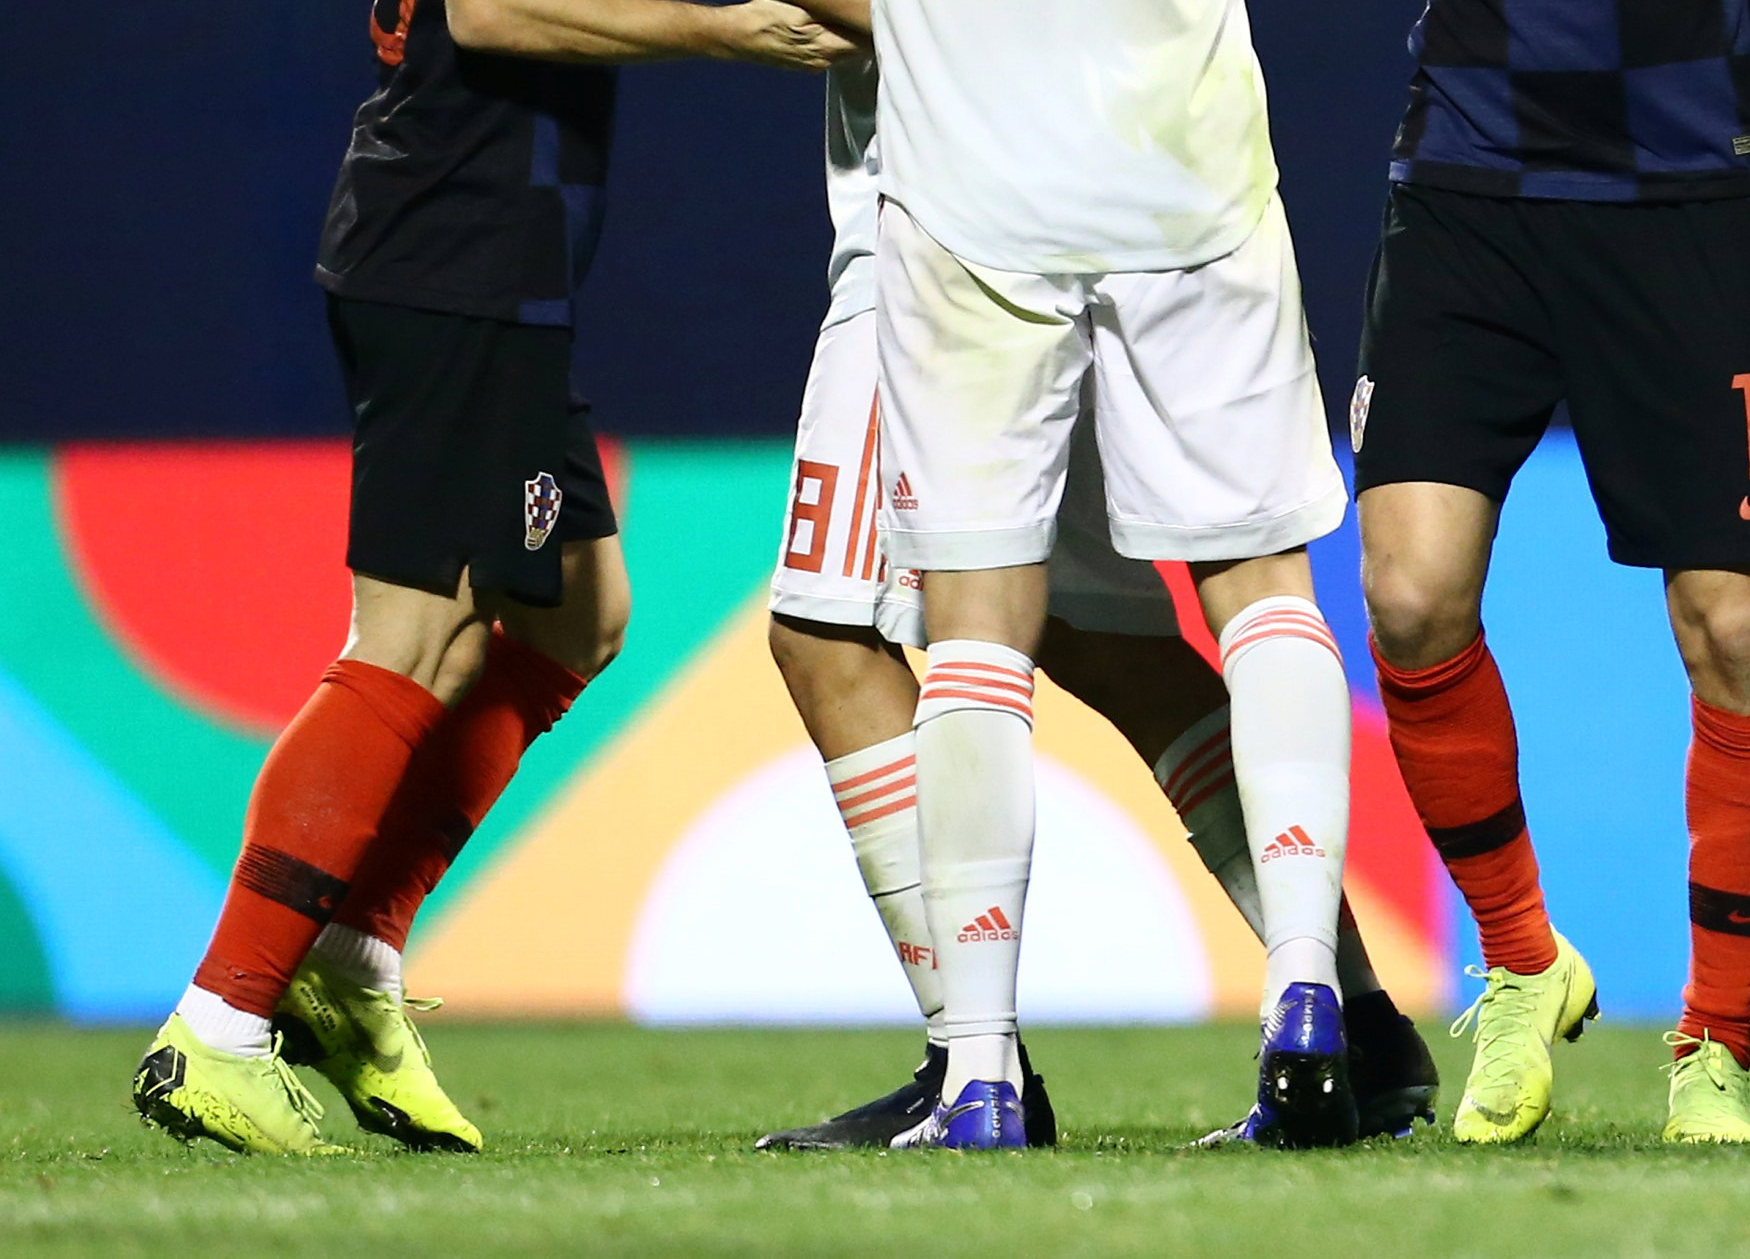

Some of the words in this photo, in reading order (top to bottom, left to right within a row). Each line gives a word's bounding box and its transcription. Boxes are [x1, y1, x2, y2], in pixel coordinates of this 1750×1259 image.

[784, 459, 839, 574] 8
[1261, 844, 1326, 863] adidas
[957, 929, 1019, 943] adidas
